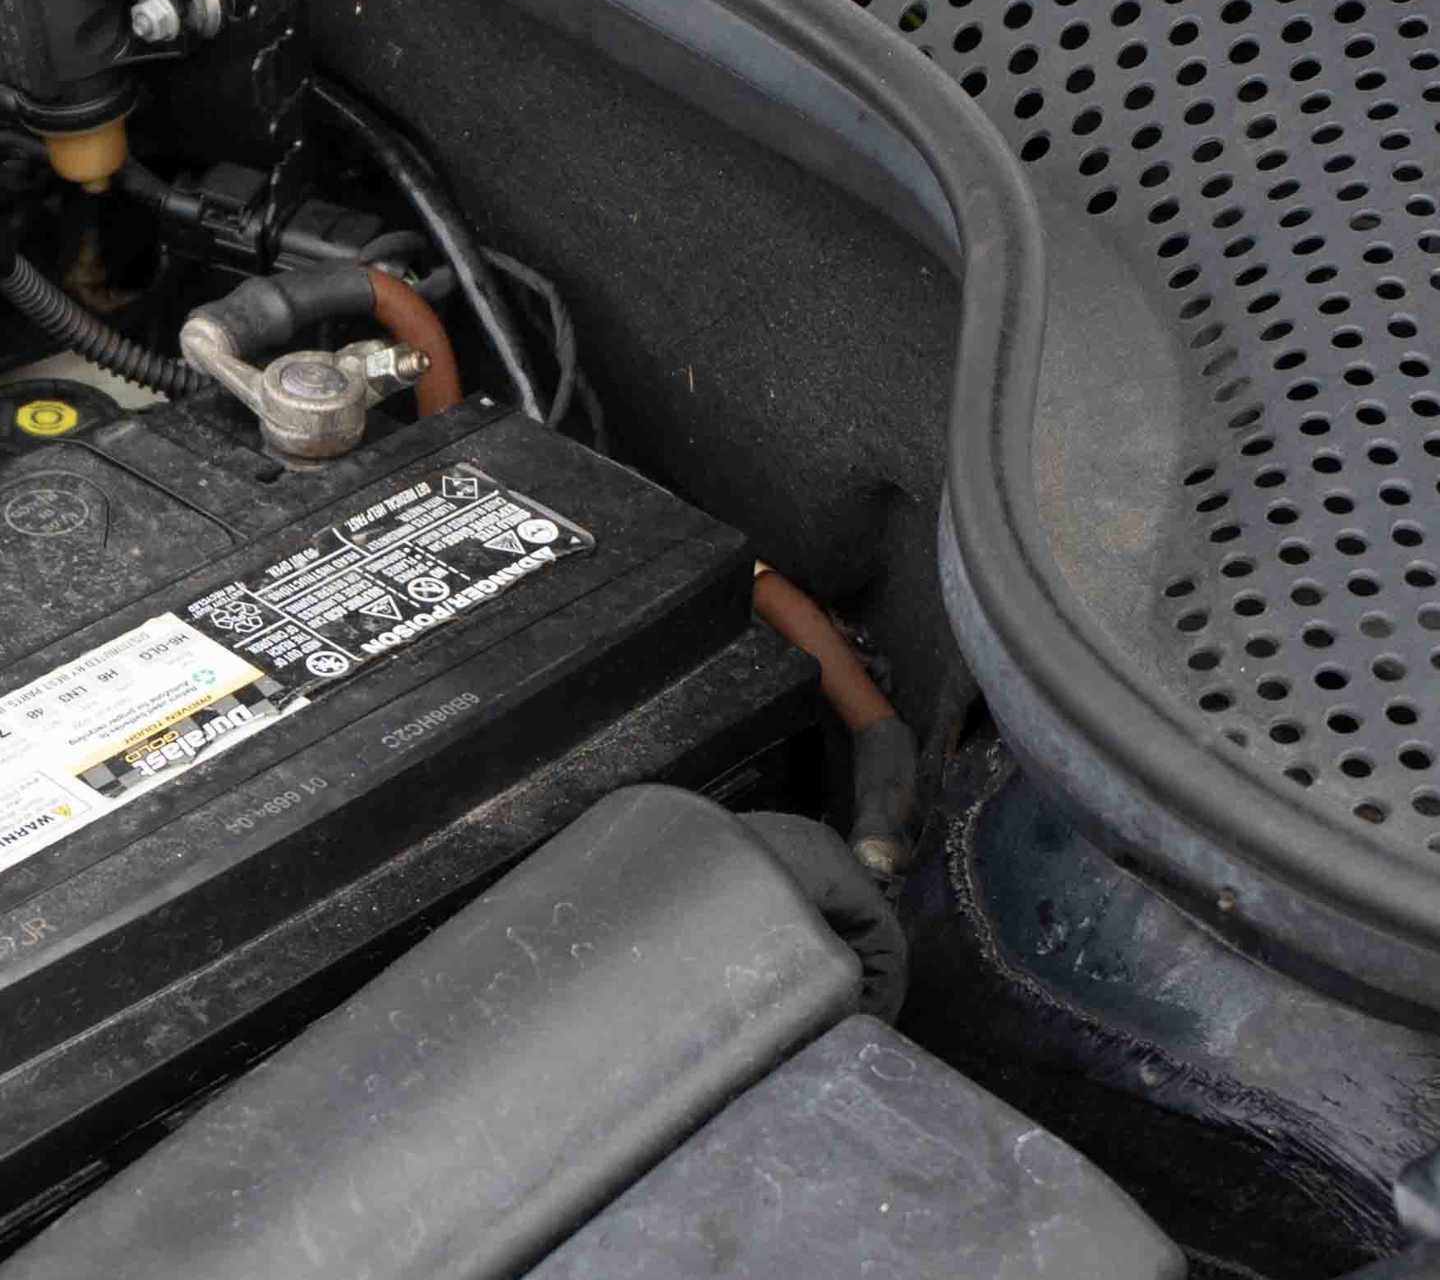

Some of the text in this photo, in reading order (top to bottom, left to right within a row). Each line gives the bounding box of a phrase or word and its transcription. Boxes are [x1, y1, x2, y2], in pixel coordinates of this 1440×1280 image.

[331, 551, 361, 569] READ
[362, 557, 540, 654] DANGER/POISON
[97, 669, 119, 682] H6
[125, 730, 180, 763] GOLD
[133, 705, 264, 780] Duralast
